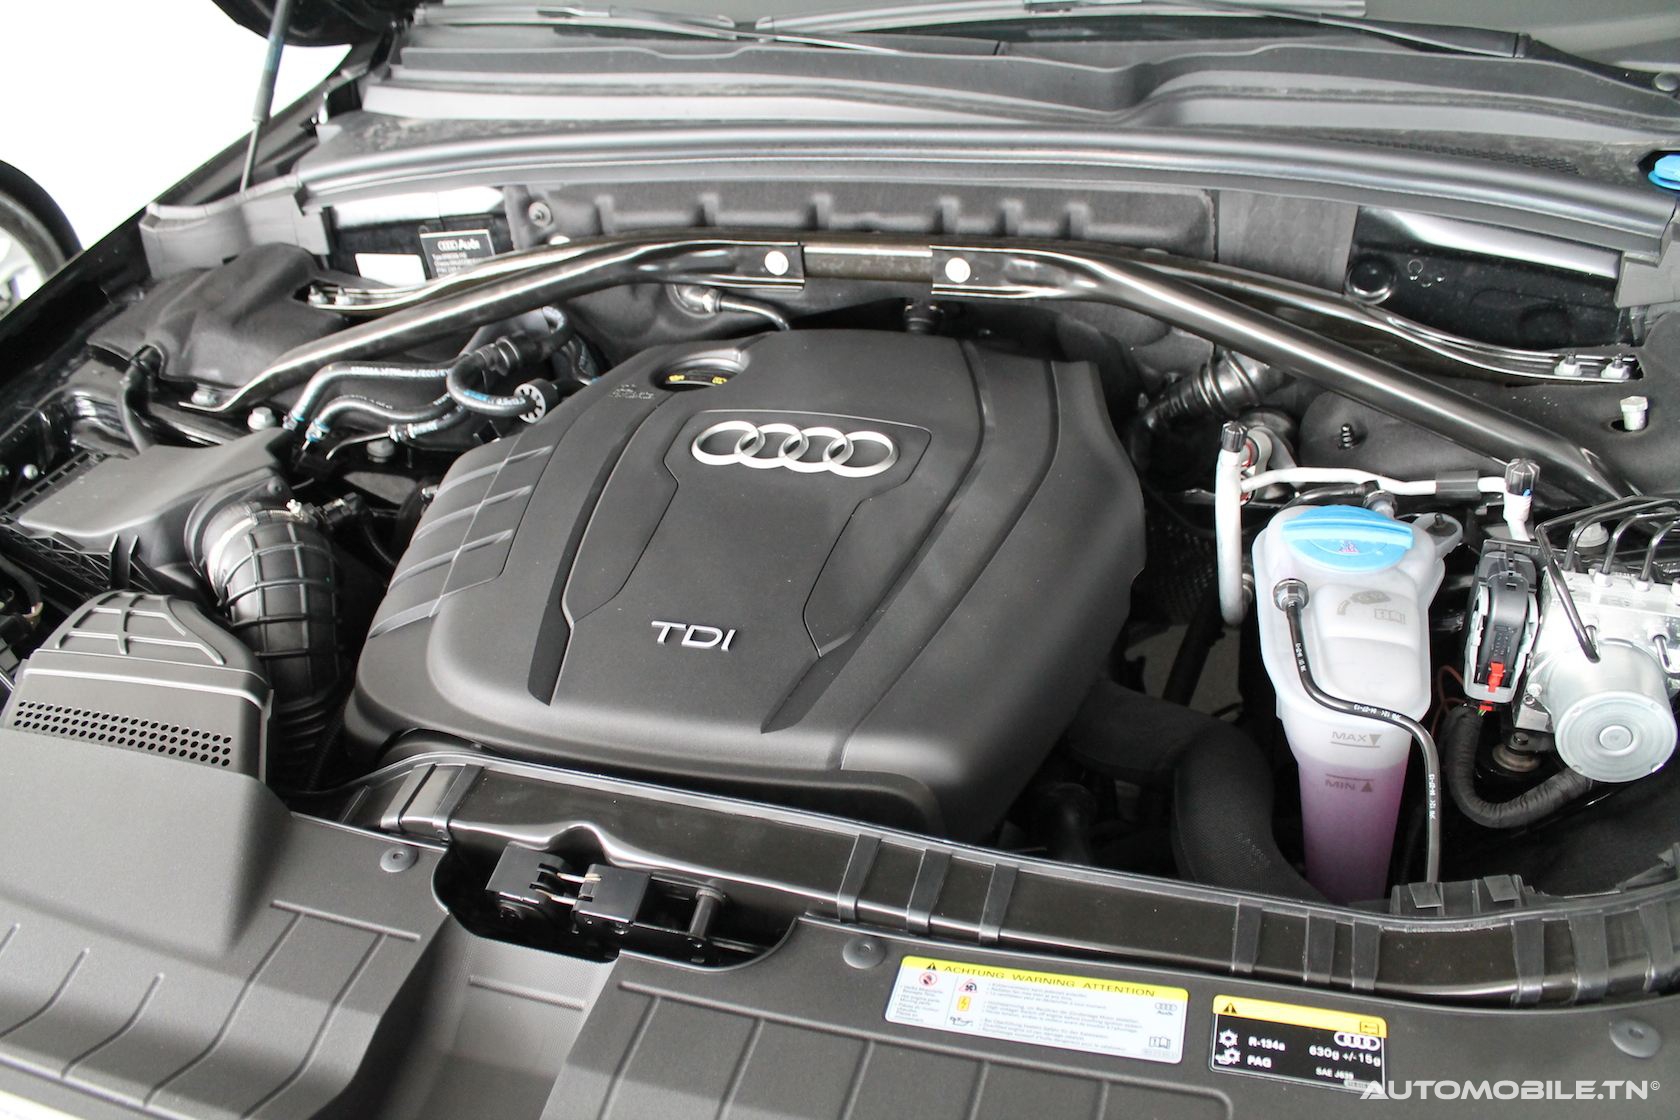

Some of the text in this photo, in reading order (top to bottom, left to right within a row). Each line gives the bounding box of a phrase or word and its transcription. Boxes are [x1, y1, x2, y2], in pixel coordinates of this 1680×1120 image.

[459, 238, 480, 251] Audi
[651, 620, 737, 652] TDI
[1331, 730, 1368, 743] MAX
[1325, 779, 1357, 792] MIN
[944, 966, 1005, 979] ACHTUNG
[1011, 973, 1075, 989] WARNING
[1082, 981, 1156, 998] ATTENTION
[1248, 1037, 1286, 1051] R-134a
[1309, 1044, 1340, 1062] 630g
[1247, 1056, 1272, 1068] PAG
[1315, 1067, 1333, 1078] SAE
